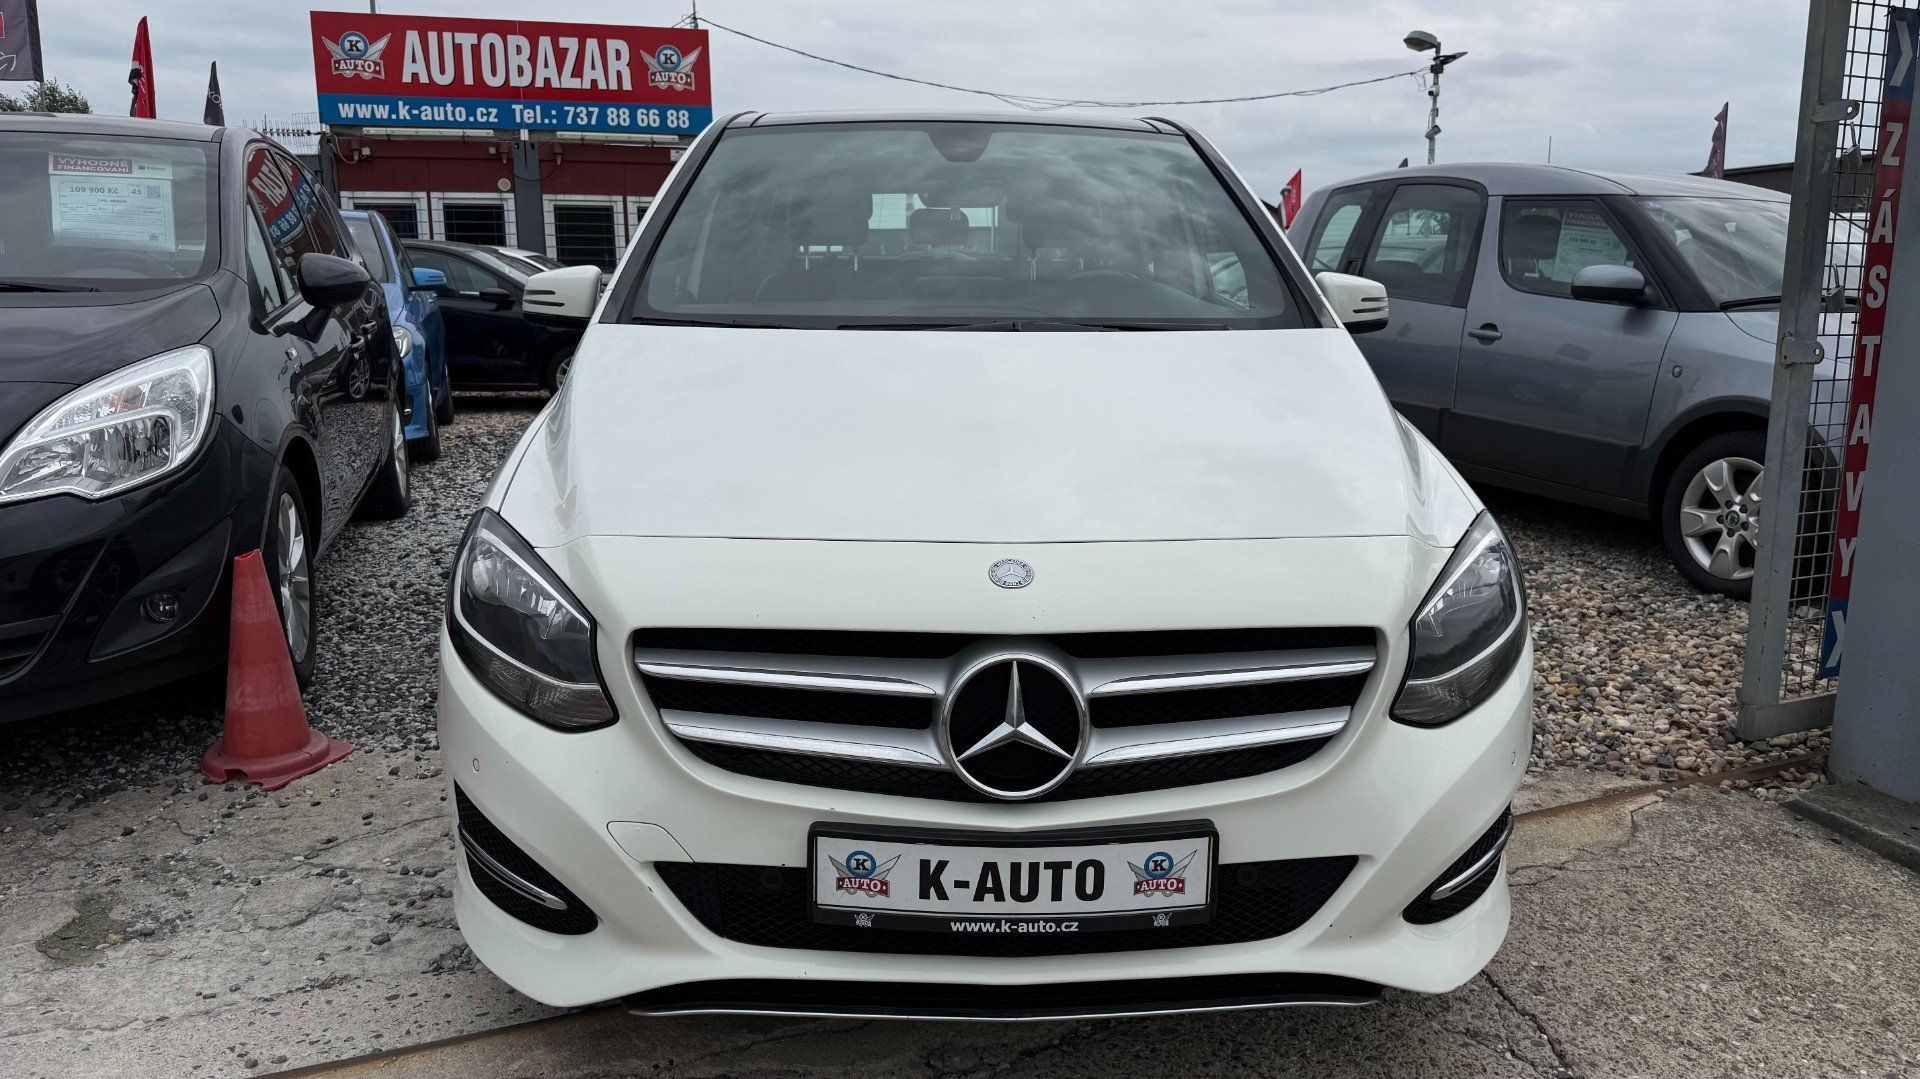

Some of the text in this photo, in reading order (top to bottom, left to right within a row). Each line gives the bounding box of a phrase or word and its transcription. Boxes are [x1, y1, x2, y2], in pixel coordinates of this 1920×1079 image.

[347, 39, 362, 52] K
[339, 59, 375, 72] AUTO
[402, 29, 633, 91] AUTOBAZAR
[662, 52, 676, 65] K
[655, 73, 686, 84] AUTO
[337, 100, 690, 129] www.k-auto.cz Tel.: 737 88 66 88
[1838, 122, 1904, 577] ZÁSTAVY
[853, 857, 870, 871] K
[1151, 858, 1167, 872] K
[842, 878, 881, 892] AUTO
[918, 858, 1106, 903] K-AUTO
[1140, 878, 1177, 891] AUTO
[950, 919, 1079, 934] www.k-auto.cz
